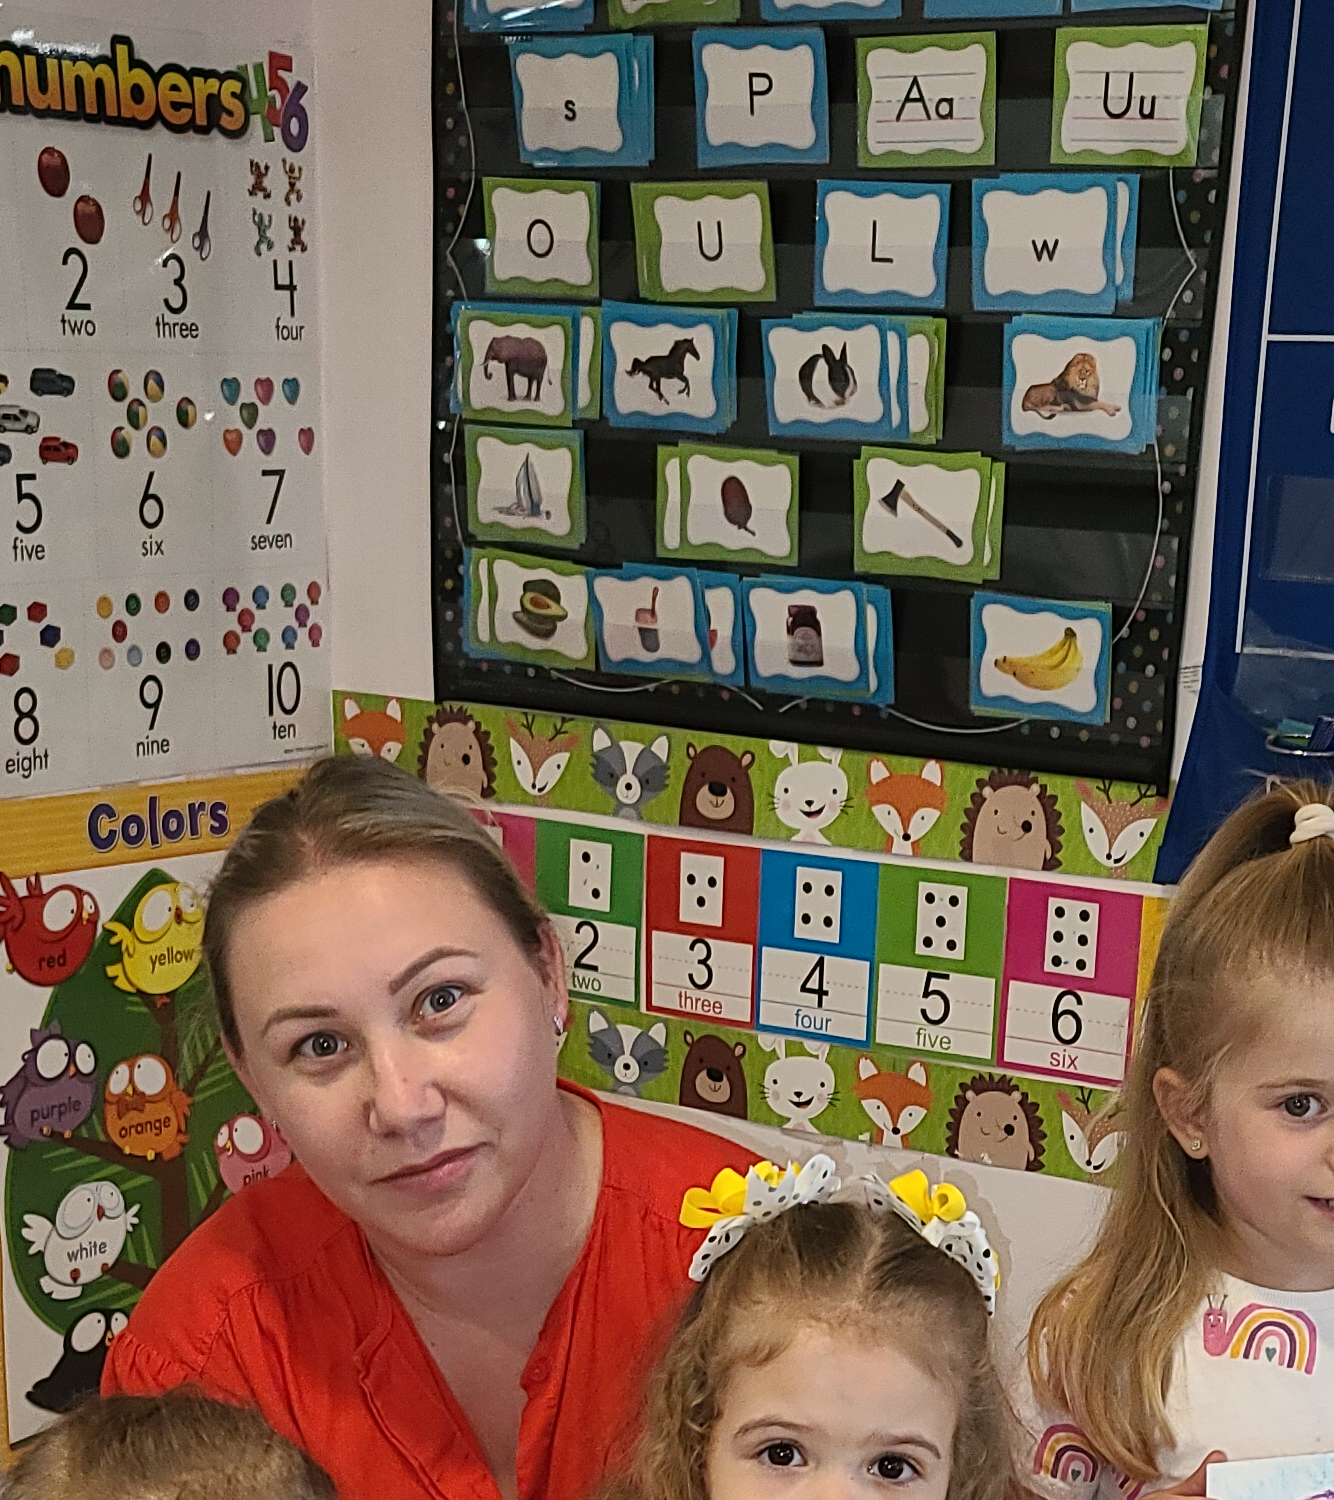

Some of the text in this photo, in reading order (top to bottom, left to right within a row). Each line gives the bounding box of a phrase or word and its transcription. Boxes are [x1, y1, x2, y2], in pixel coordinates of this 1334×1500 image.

[748, 72, 773, 116] P
[895, 75, 955, 123] Aa
[1103, 71, 1156, 120] Uu
[564, 100, 577, 122] s
[527, 219, 554, 258] O
[697, 220, 723, 262] U
[871, 219, 894, 264] L
[1031, 238, 1059, 262] w
[62, 247, 91, 311] 2
[161, 252, 188, 314] 3
[272, 259, 298, 317] 4
[60, 315, 97, 337] two
[155, 314, 200, 339] three
[275, 317, 305, 341] four
[15, 473, 43, 534] 5
[138, 471, 164, 530] 6
[261, 468, 287, 525] 7
[12, 536, 45, 562] five
[141, 536, 164, 556] six
[250, 530, 293, 550] seven
[139, 674, 164, 731] 9
[267, 661, 302, 717] 10
[13, 686, 40, 746] 8
[271, 720, 297, 740] ten
[136, 735, 170, 758] nine
[5, 751, 50, 778] eight
[87, 795, 229, 852] Colors
[39, 949, 67, 970] red
[149, 947, 195, 974] yellow
[573, 920, 600, 973] 2
[687, 937, 714, 990] 3
[571, 970, 602, 993] two
[799, 955, 829, 1008] 4
[678, 990, 723, 1015] three
[920, 971, 952, 1026] 5
[794, 1009, 832, 1034] four
[1051, 989, 1083, 1046] 6
[915, 1027, 952, 1052] five
[1049, 1049, 1079, 1072] six
[30, 1096, 82, 1124] purple
[118, 1115, 172, 1140] orange
[244, 1165, 270, 1187] pink
[66, 1240, 108, 1263] white
